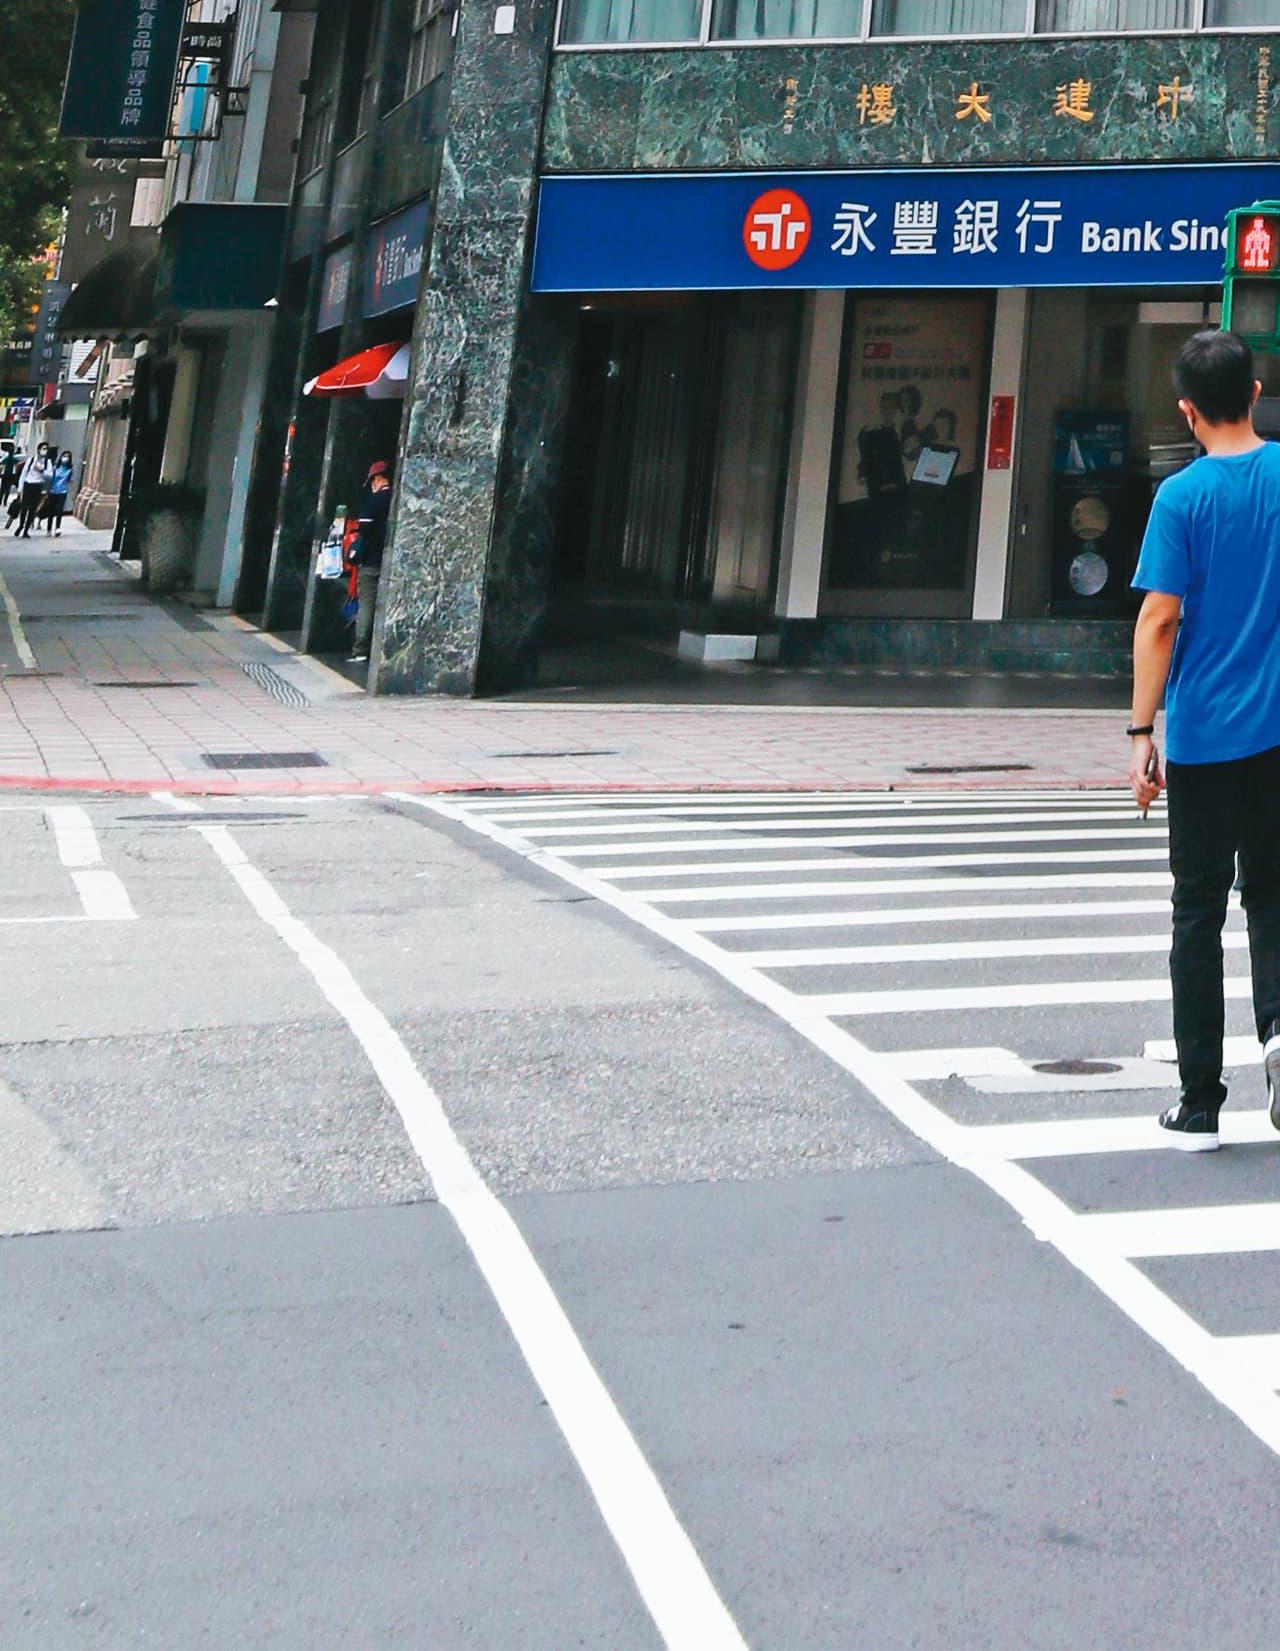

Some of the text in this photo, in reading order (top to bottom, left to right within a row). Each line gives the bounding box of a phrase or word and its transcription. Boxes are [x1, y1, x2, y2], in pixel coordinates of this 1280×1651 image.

[831, 199, 1062, 256] 永豐銀行
[1082, 222, 1162, 253] Bank
